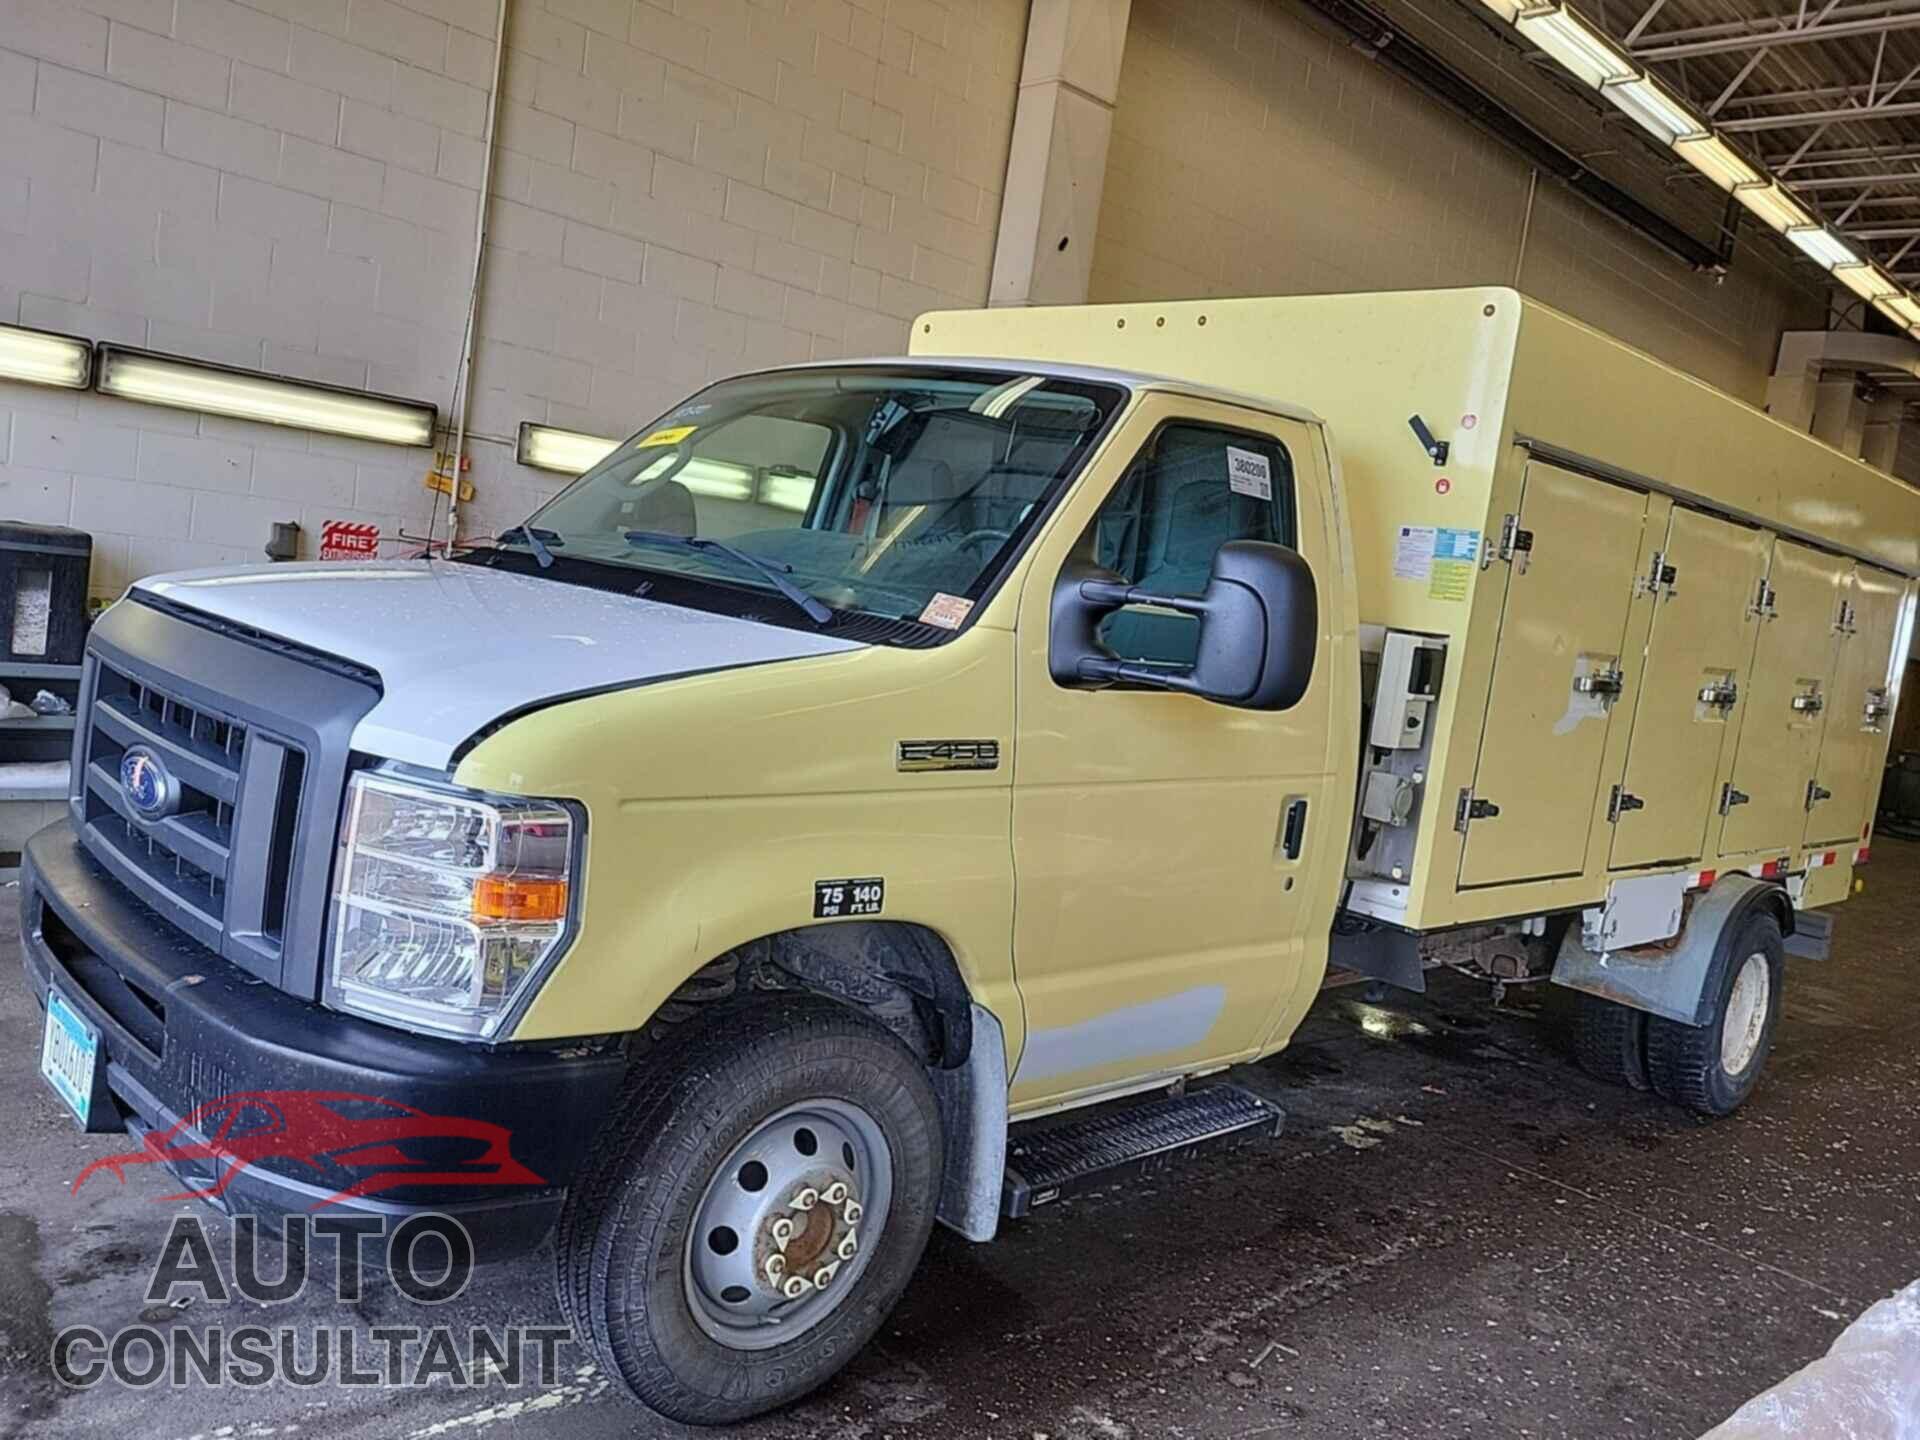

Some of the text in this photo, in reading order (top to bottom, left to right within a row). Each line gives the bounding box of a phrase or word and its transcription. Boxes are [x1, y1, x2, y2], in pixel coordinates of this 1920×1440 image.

[332, 532, 371, 549] FIRE
[821, 887, 844, 904] 75
[853, 885, 882, 902] 140
